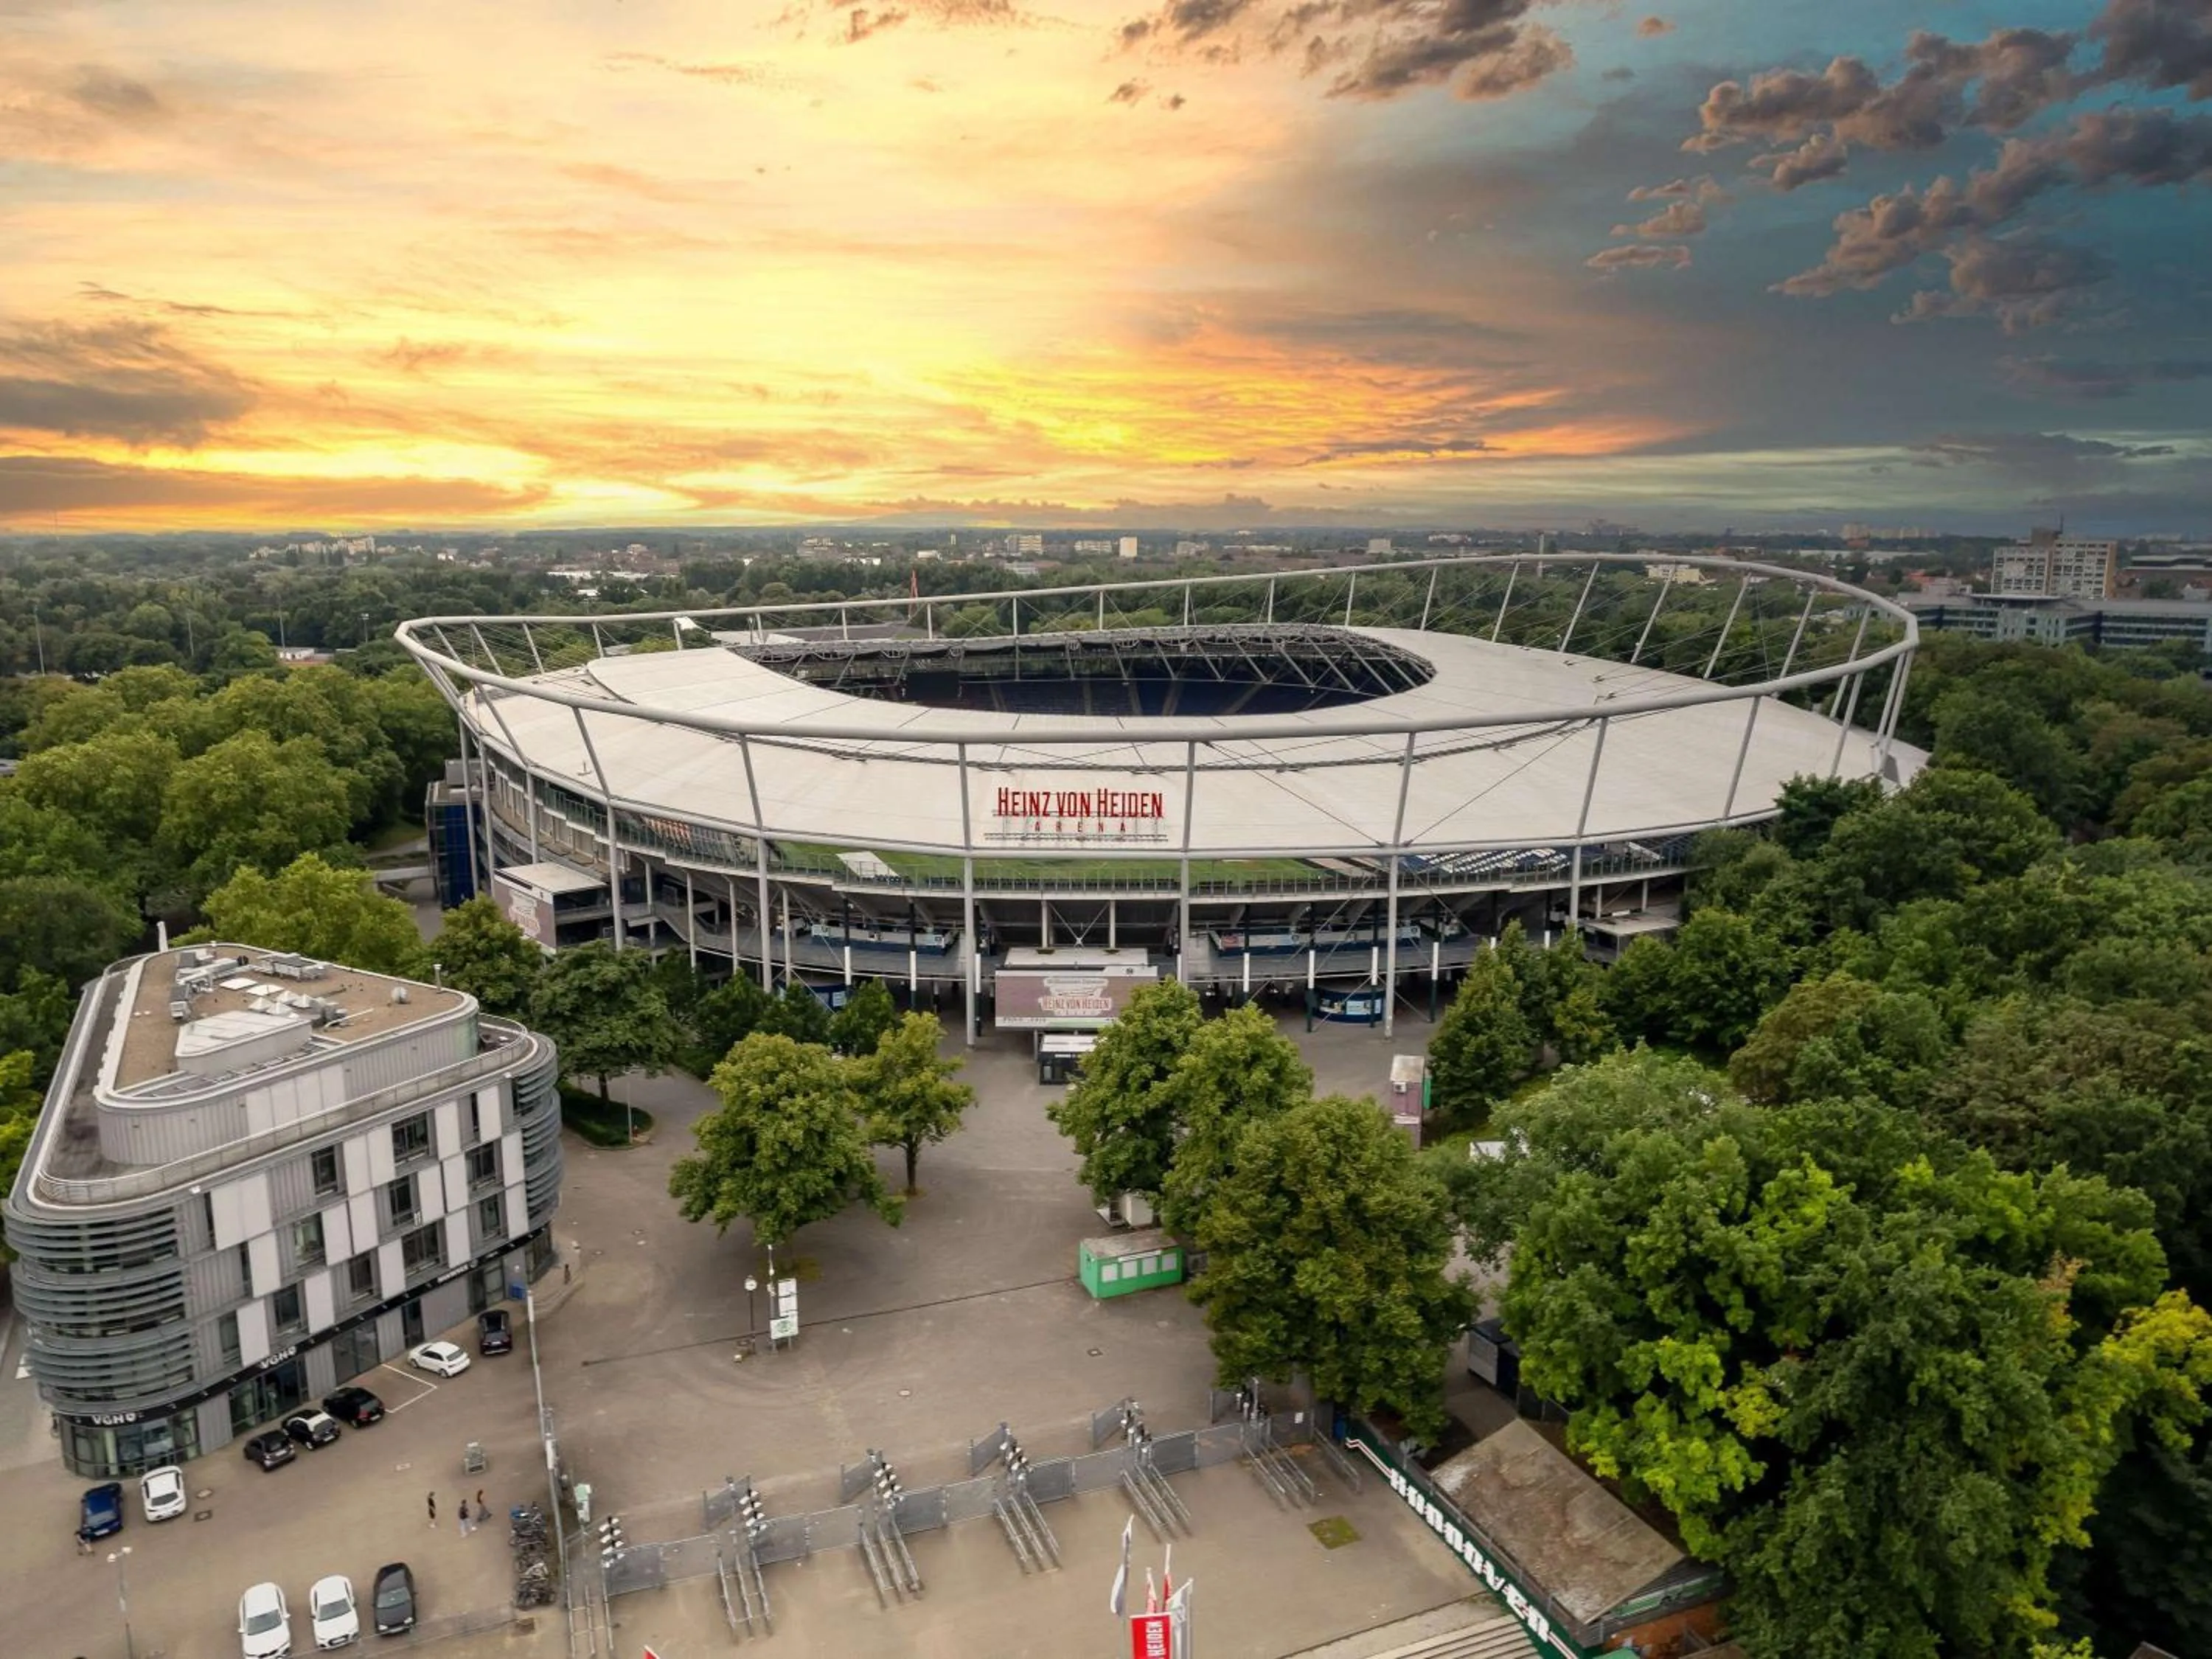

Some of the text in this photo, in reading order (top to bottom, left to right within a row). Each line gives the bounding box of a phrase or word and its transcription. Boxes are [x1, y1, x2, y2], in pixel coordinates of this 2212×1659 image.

[998, 787, 1164, 818] HEINZ VON HEIDEN
[1034, 821, 1126, 832] ARENA
